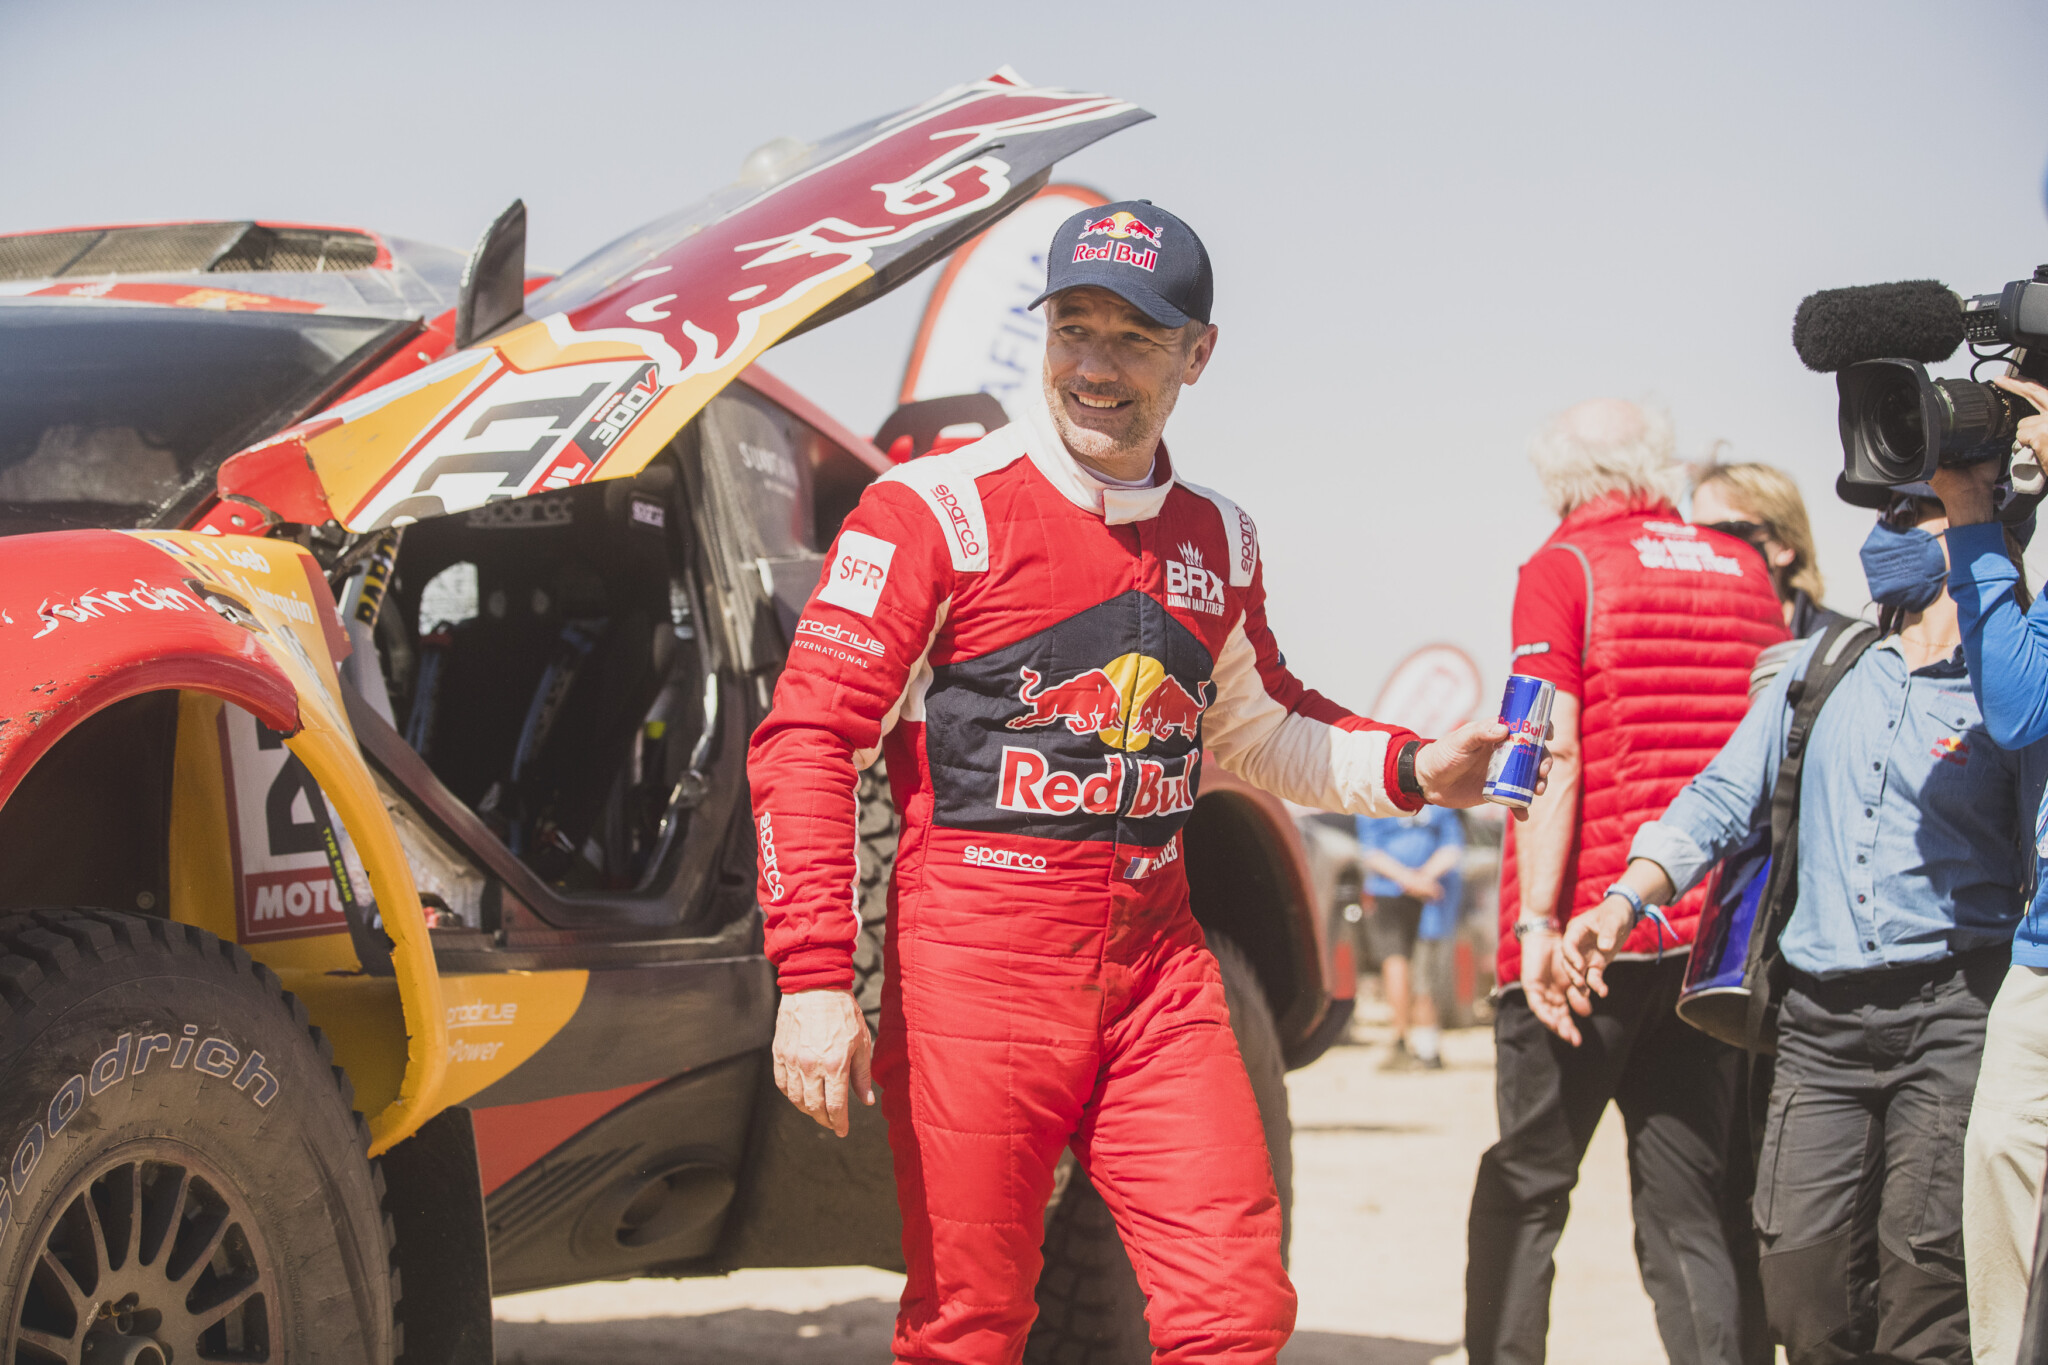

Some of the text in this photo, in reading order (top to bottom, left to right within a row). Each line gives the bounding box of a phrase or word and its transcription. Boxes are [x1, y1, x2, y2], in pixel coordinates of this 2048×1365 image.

[1072, 240, 1158, 272] Red Bull
[589, 364, 660, 447] 300V
[933, 484, 979, 558] sparco
[1235, 506, 1256, 575] sparco
[840, 555, 884, 590] SFR
[1166, 560, 1225, 605] BRX
[794, 640, 868, 669] NTERNATIONAL
[1521, 720, 1545, 738] Bull
[996, 745, 1200, 818] Red Bull
[323, 827, 352, 903] TYRE REPAIR
[760, 811, 784, 902] sparco
[963, 845, 1047, 873] sparco
